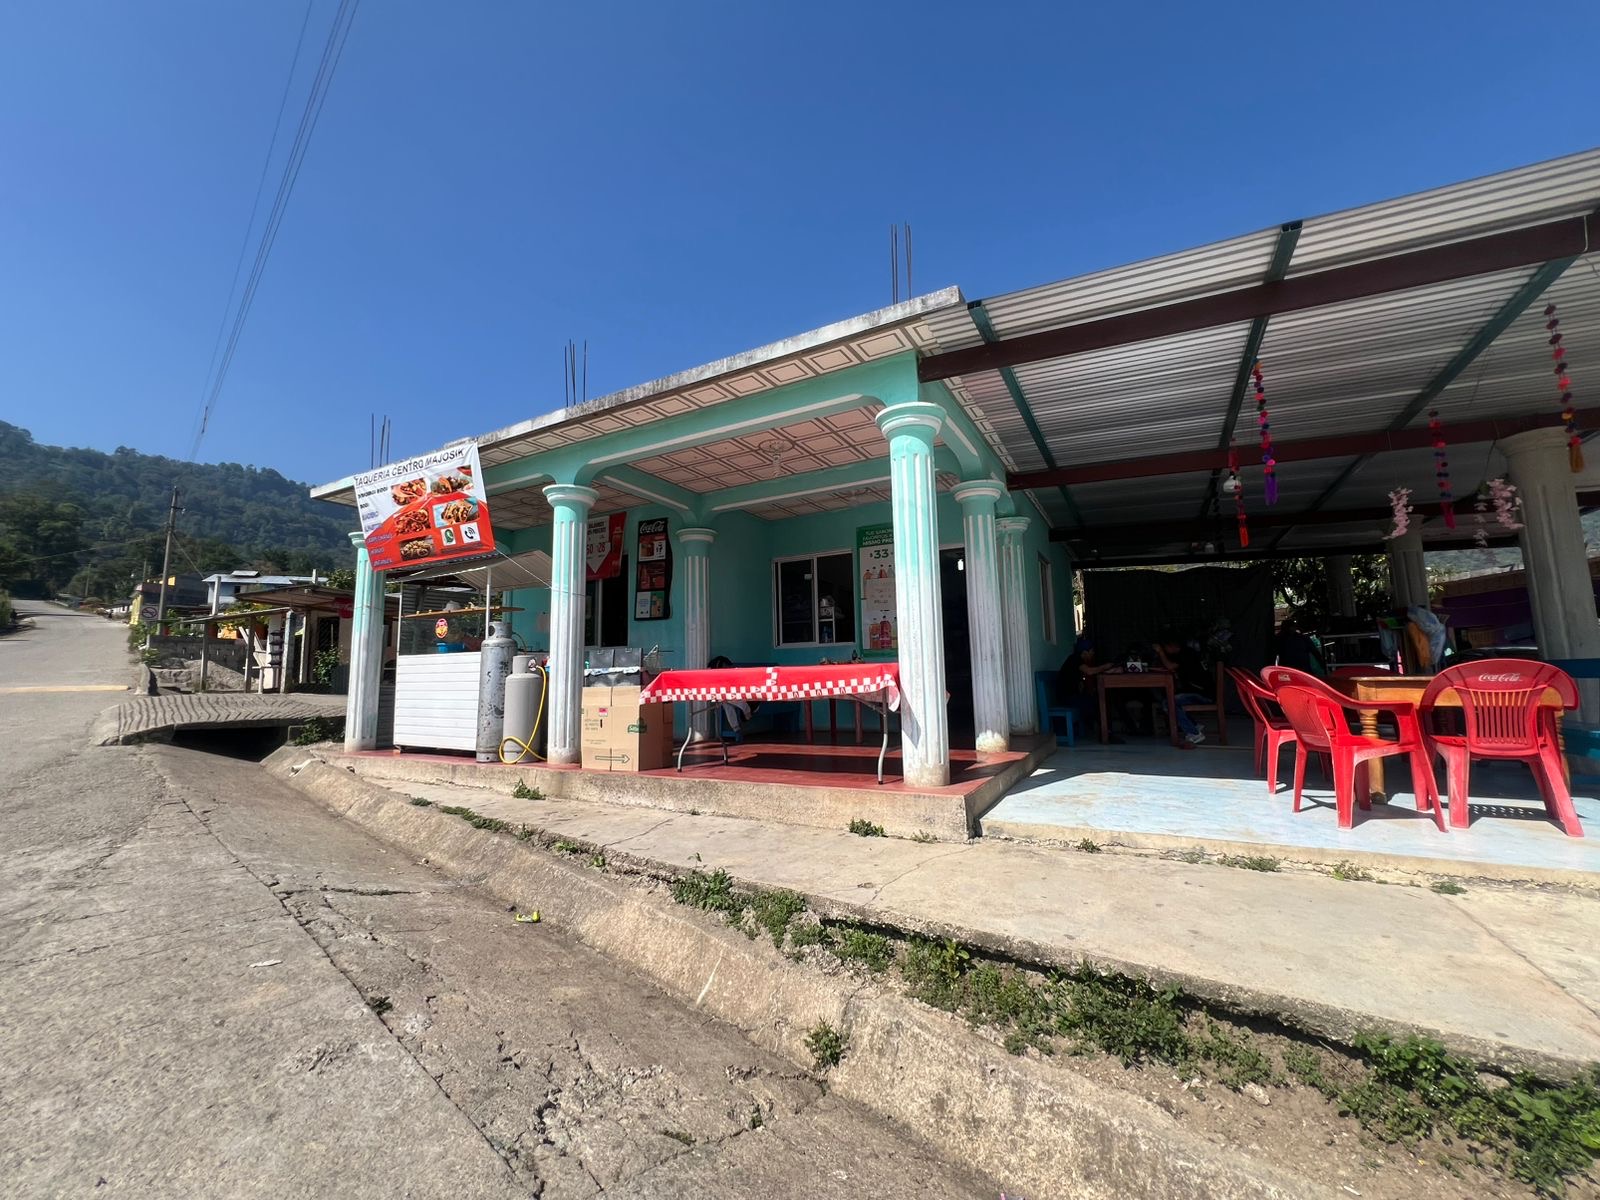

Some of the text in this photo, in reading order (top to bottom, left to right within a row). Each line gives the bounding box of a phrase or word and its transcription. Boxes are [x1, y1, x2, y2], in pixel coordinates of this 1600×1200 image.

[355, 448, 464, 485] TAQUERIA CENTRO MAJOSIK
